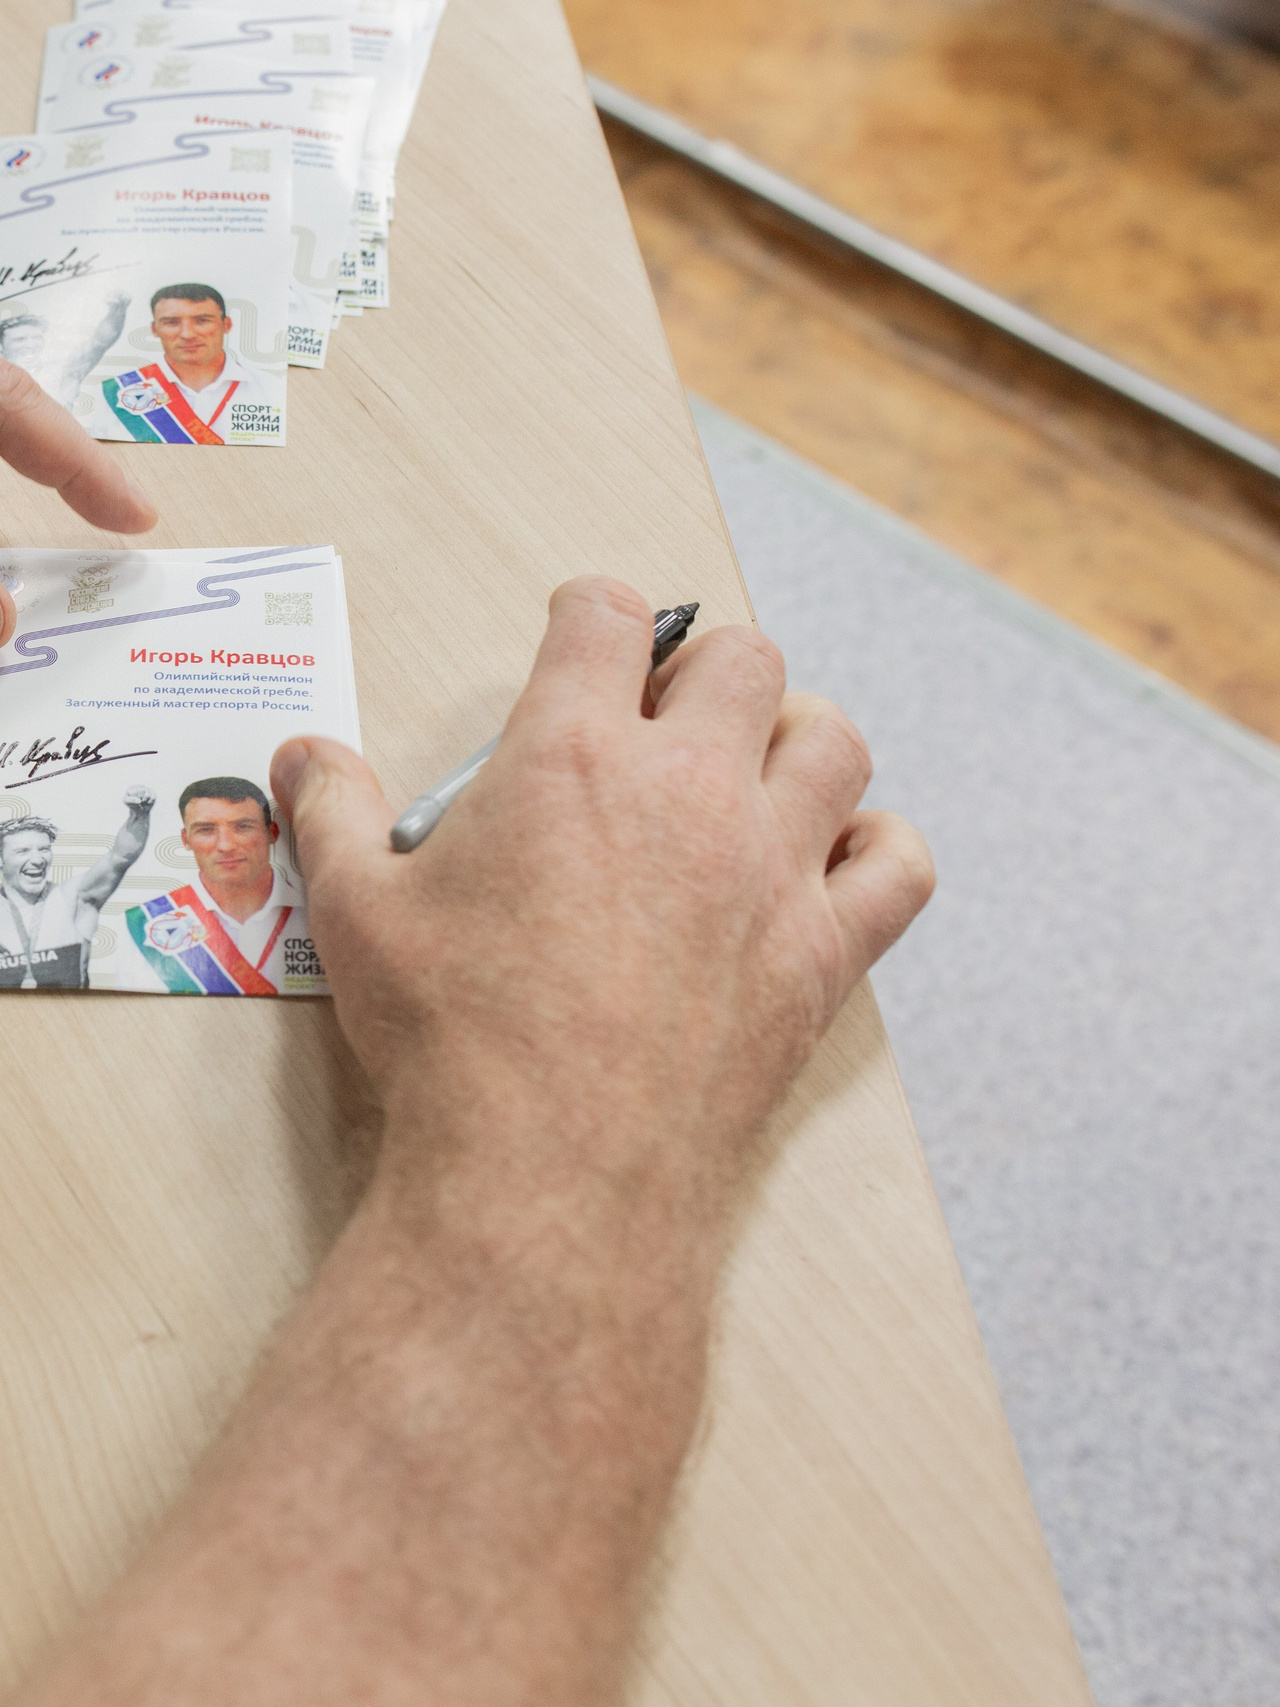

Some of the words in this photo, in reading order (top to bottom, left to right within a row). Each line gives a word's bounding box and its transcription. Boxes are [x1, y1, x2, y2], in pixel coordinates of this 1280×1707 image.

[115, 188, 177, 203] Игорь
[182, 188, 270, 203] Кравцов
[288, 325, 316, 337] ОРТ
[288, 343, 321, 355] ИЗНИ
[231, 404, 272, 414] СПОРТ
[231, 413, 280, 423] НОРМА
[231, 422, 280, 432] ЖИЗНИ
[130, 648, 203, 667] Игорь
[210, 649, 316, 669] Кравцов
[154, 671, 251, 682] Олимпийский
[252, 674, 313, 684] чемпион
[133, 686, 150, 694] по
[154, 686, 260, 696] академической
[263, 687, 313, 698] гребле.
[65, 698, 160, 709] Заслуженный
[163, 700, 211, 710] мастер
[213, 701, 258, 711] спорта
[262, 701, 314, 712] России.
[284, 938, 315, 950] СПО
[284, 951, 320, 963] НОР
[285, 963, 326, 975] ЖИЗ
